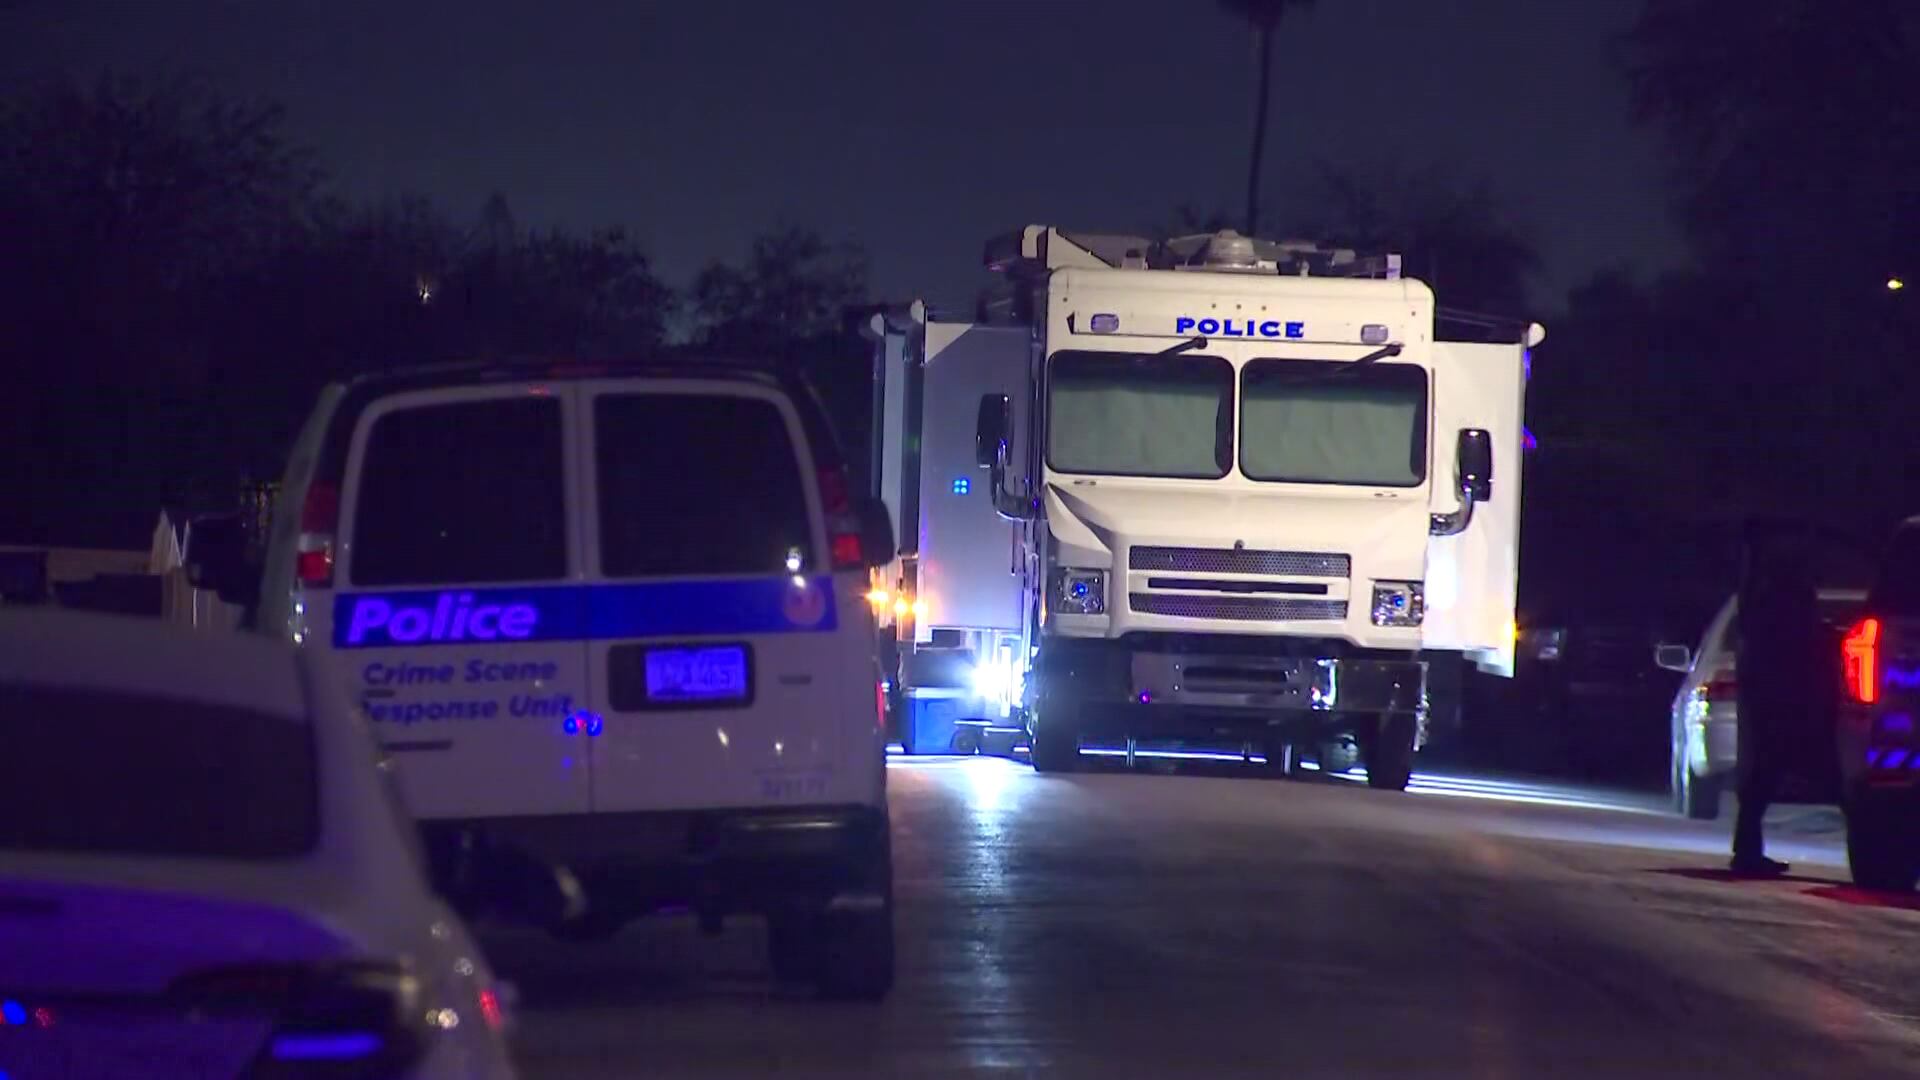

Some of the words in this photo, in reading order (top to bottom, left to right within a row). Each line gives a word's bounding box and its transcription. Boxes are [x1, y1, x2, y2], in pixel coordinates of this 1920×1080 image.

[1176, 317, 1304, 338] POLICE
[349, 592, 537, 643] Police
[363, 661, 454, 685] Crime
[465, 659, 557, 682] Scene
[509, 693, 573, 718] Unit
